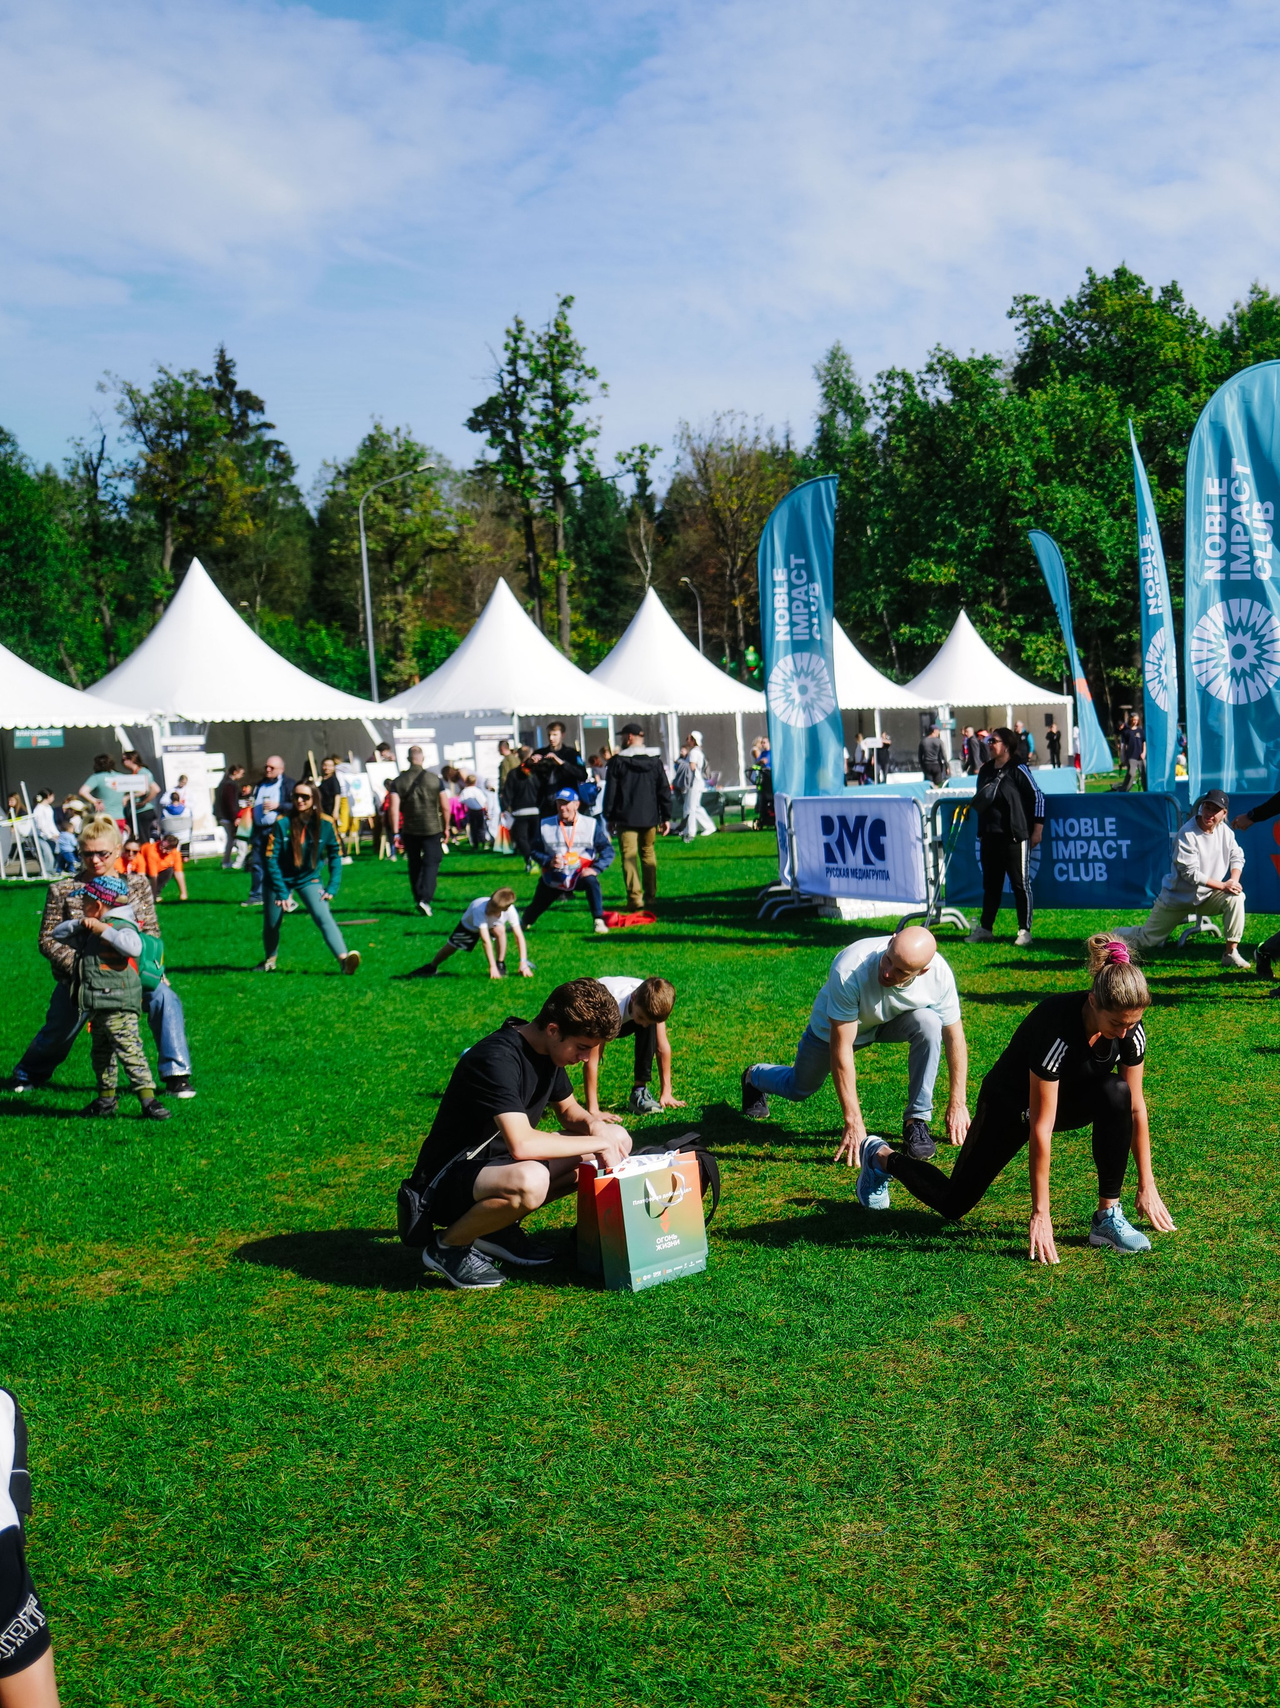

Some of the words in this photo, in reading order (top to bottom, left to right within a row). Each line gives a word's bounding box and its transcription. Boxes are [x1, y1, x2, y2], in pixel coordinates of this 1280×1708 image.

[1204, 477, 1228, 580] NOBLE
[1230, 457, 1251, 581] IMPACT
[1252, 501, 1275, 581] CLUB
[790, 553, 810, 641] IMPACT
[1140, 534, 1160, 616] NOBLE
[773, 567, 791, 641] NOBLE
[821, 815, 887, 866] RMG
[1050, 817, 1117, 837] NOBLE
[1051, 839, 1131, 860] IMPACT
[825, 867, 850, 878] РУССКАЯ
[850, 868, 891, 881] МЕДИАГРУППА
[1053, 862, 1108, 882] CLUB
[655, 1239, 680, 1252] ЖИЗНИ
[656, 1234, 678, 1244] ОГОНЬ
